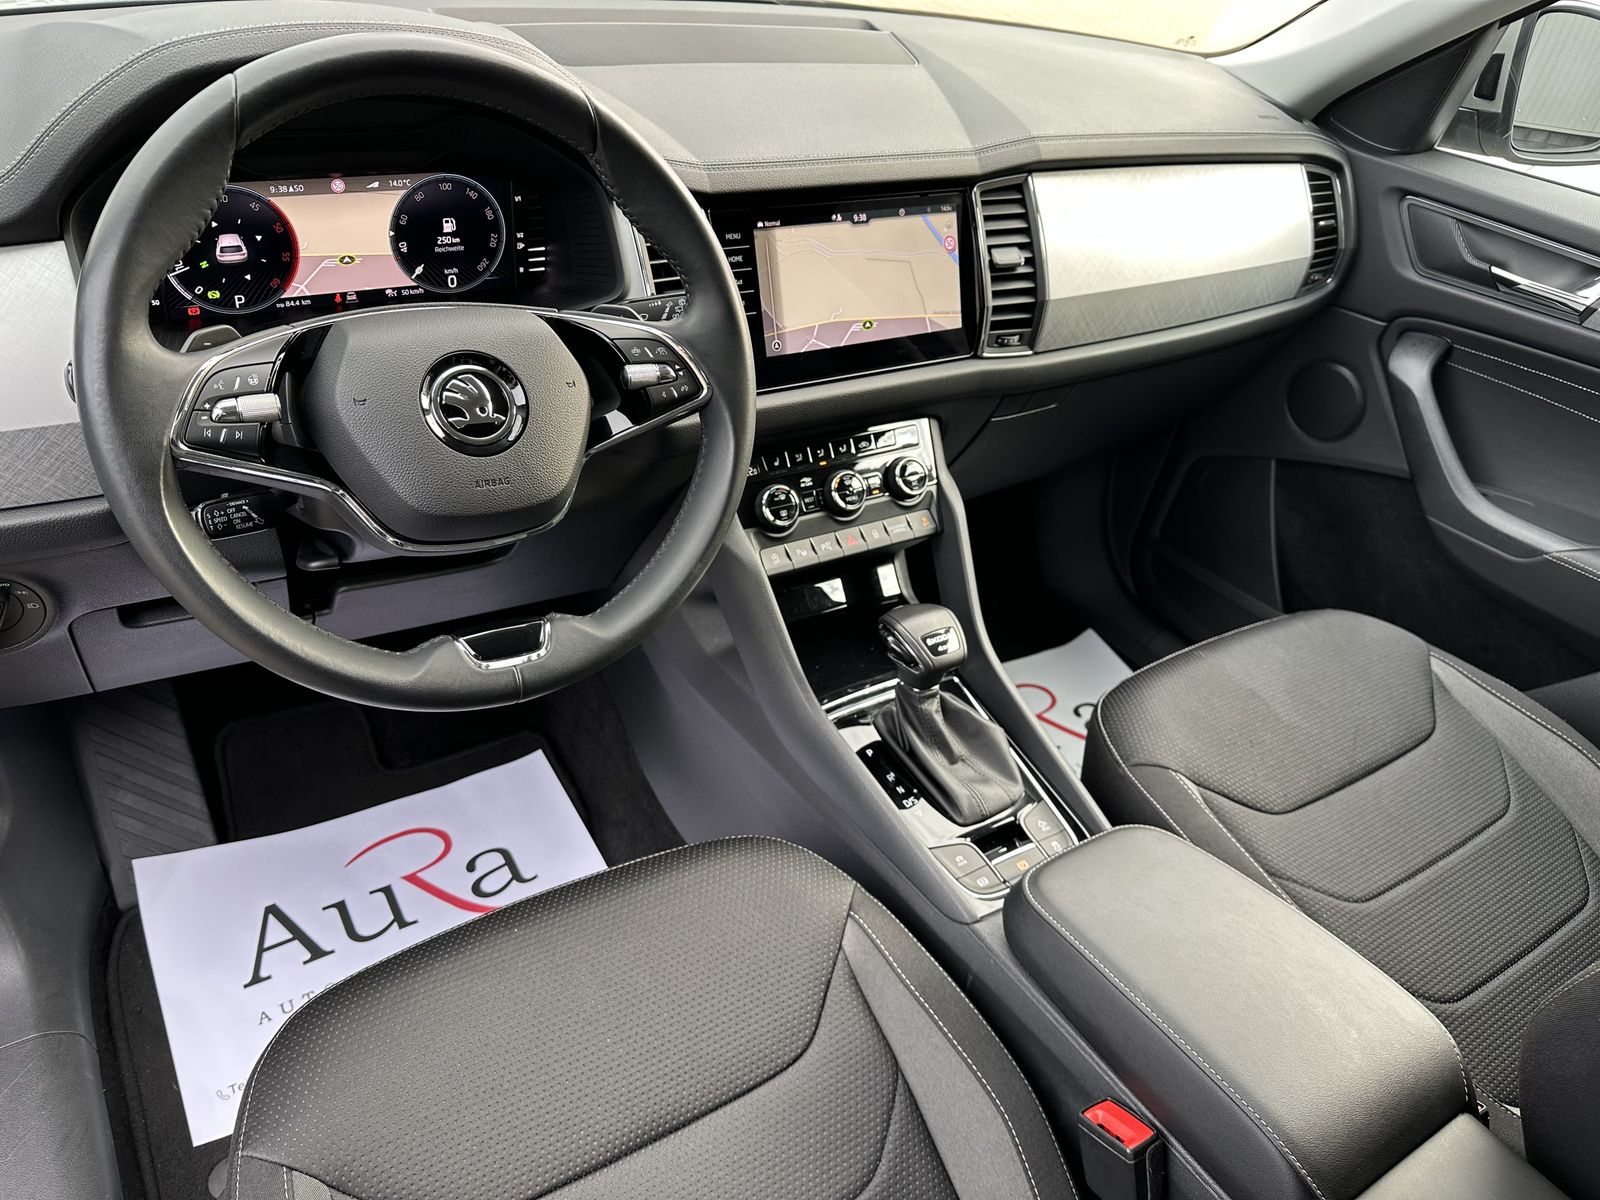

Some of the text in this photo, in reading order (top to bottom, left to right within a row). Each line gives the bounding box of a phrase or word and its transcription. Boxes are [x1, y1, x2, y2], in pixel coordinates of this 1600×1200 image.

[269, 185, 288, 193] 9:38
[438, 182, 452, 191] 100
[414, 191, 425, 202] 80
[465, 187, 478, 200] 140
[249, 202, 261, 212] 45
[484, 206, 495, 221] 180
[853, 213, 867, 222] 9:38
[399, 214, 408, 225] 60
[437, 235, 452, 245] 250
[489, 233, 498, 248] 220
[398, 241, 408, 253] 40
[434, 244, 465, 253] Reichweite
[728, 255, 743, 263] HOME
[476, 258, 490, 272] 260
[447, 275, 457, 288] 0
[194, 286, 204, 295] 0
[234, 295, 245, 309] P
[475, 476, 511, 489] AIRBAG
[230, 511, 247, 519] CANCEL
[259, 982, 334, 1026] AUT
[228, 1082, 245, 1094] Te
